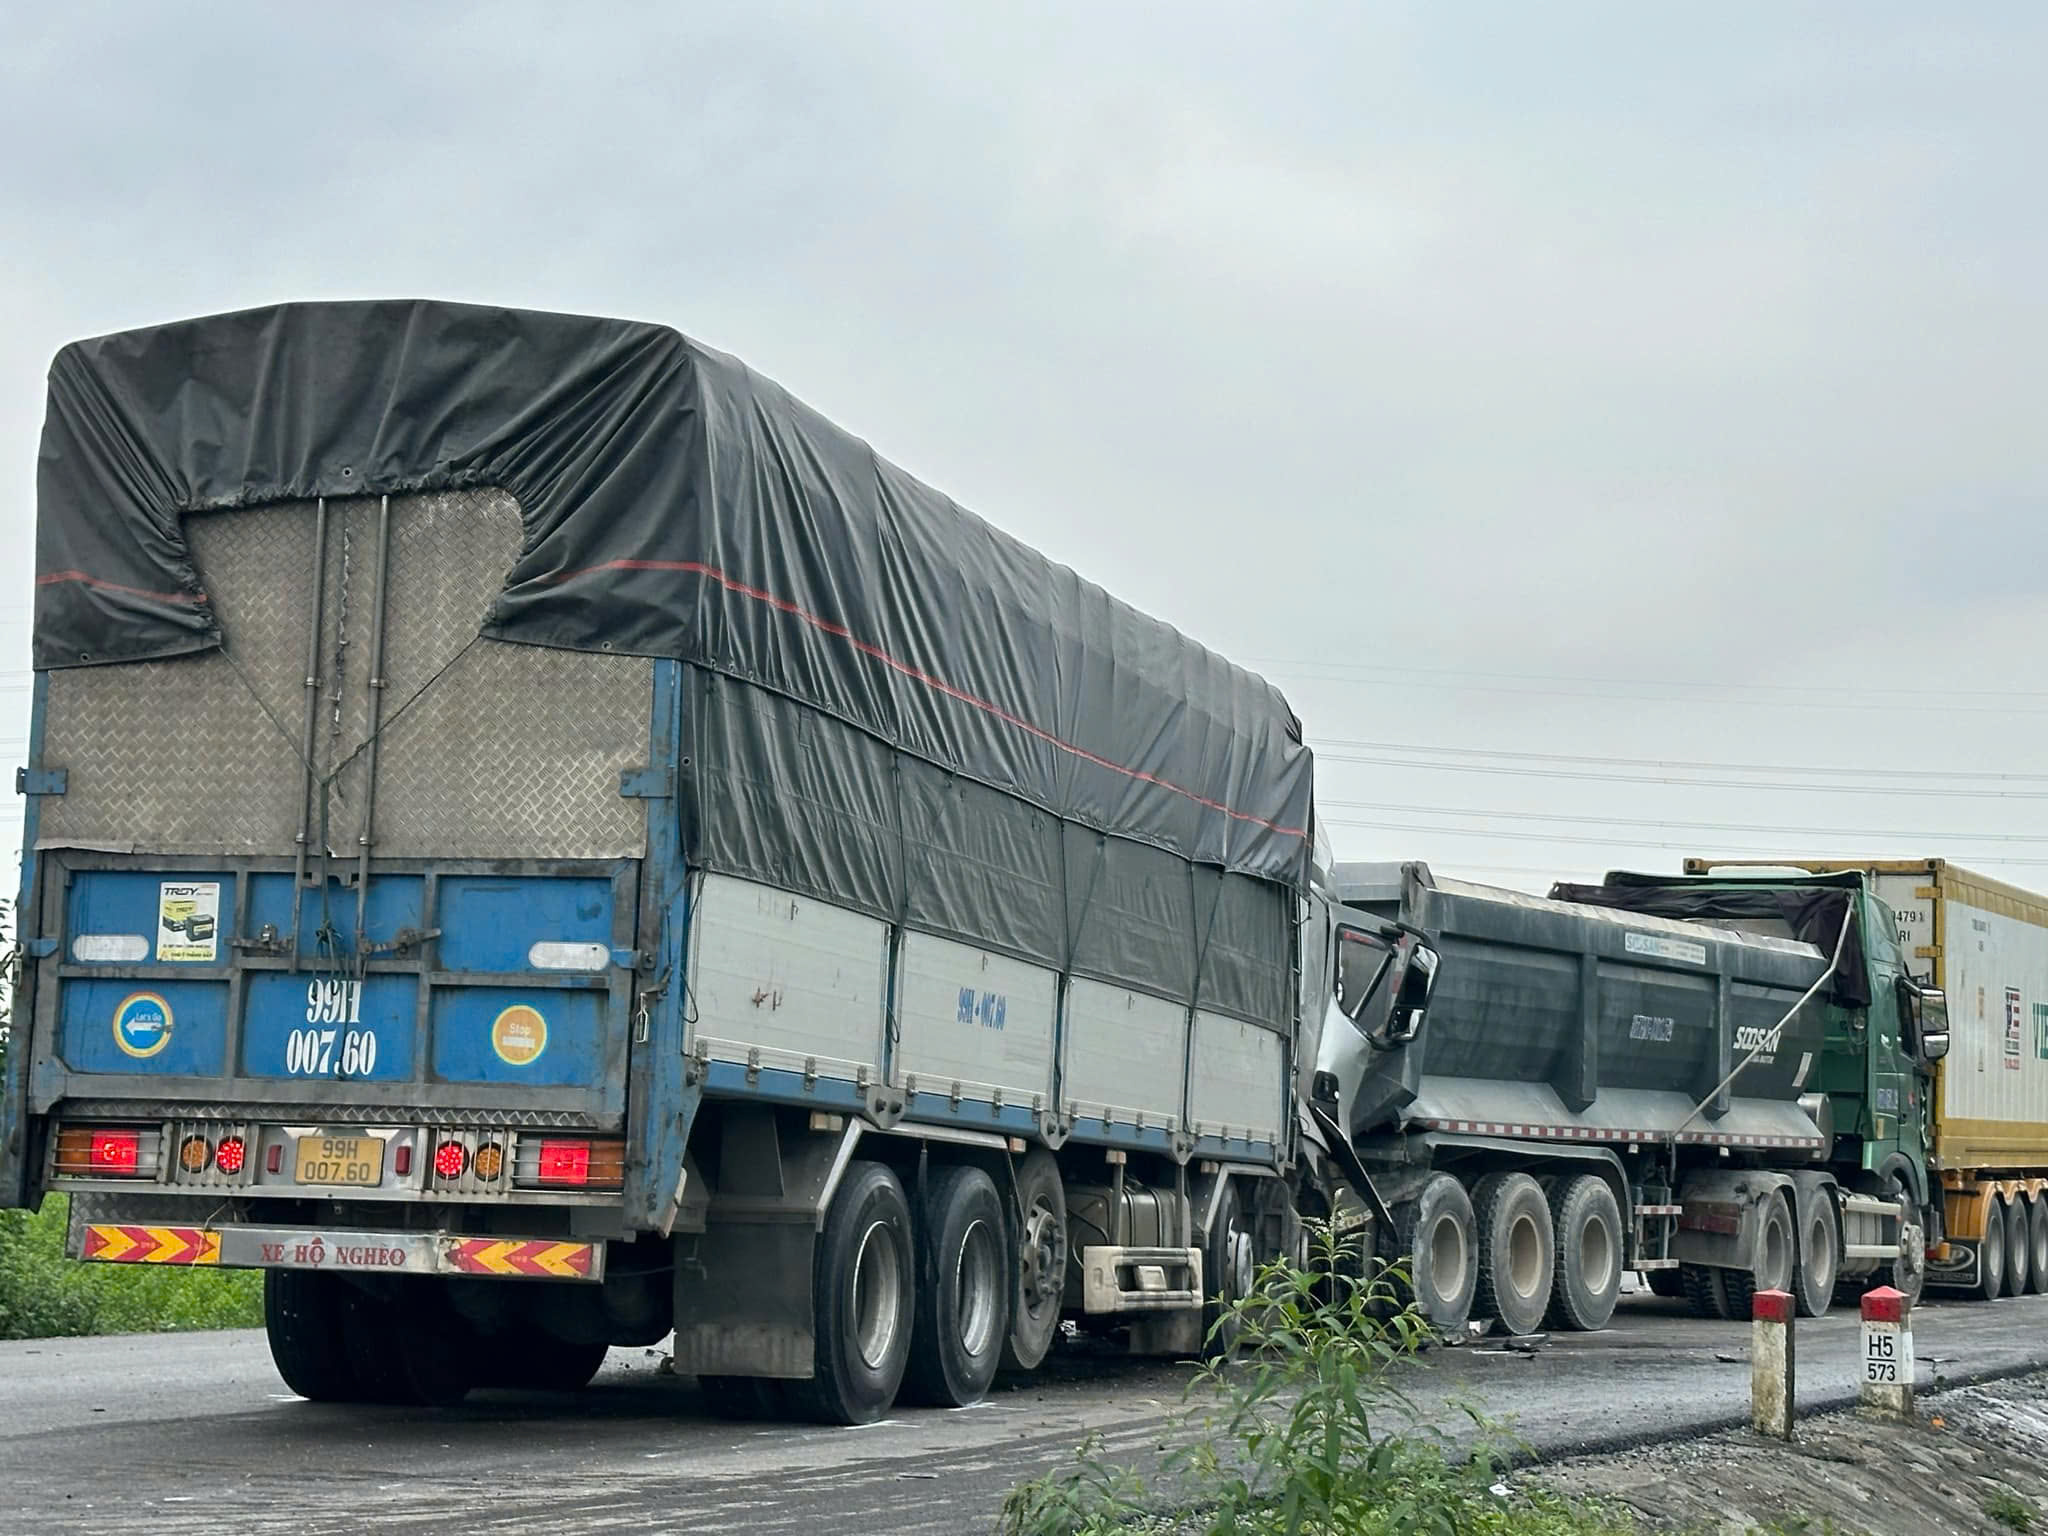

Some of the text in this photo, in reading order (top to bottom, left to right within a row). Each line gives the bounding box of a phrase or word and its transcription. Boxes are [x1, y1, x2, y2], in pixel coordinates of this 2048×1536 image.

[164, 887, 199, 896] TROY
[306, 979, 362, 1023] 99H
[286, 1029, 376, 1075] 007.60
[322, 1140, 358, 1159] 99H
[304, 1161, 370, 1181] 007.60
[261, 1243, 285, 1262] XE
[294, 1236, 326, 1269] HỘ
[1868, 1335, 1893, 1357] H5
[1867, 1363, 1896, 1382] 573
